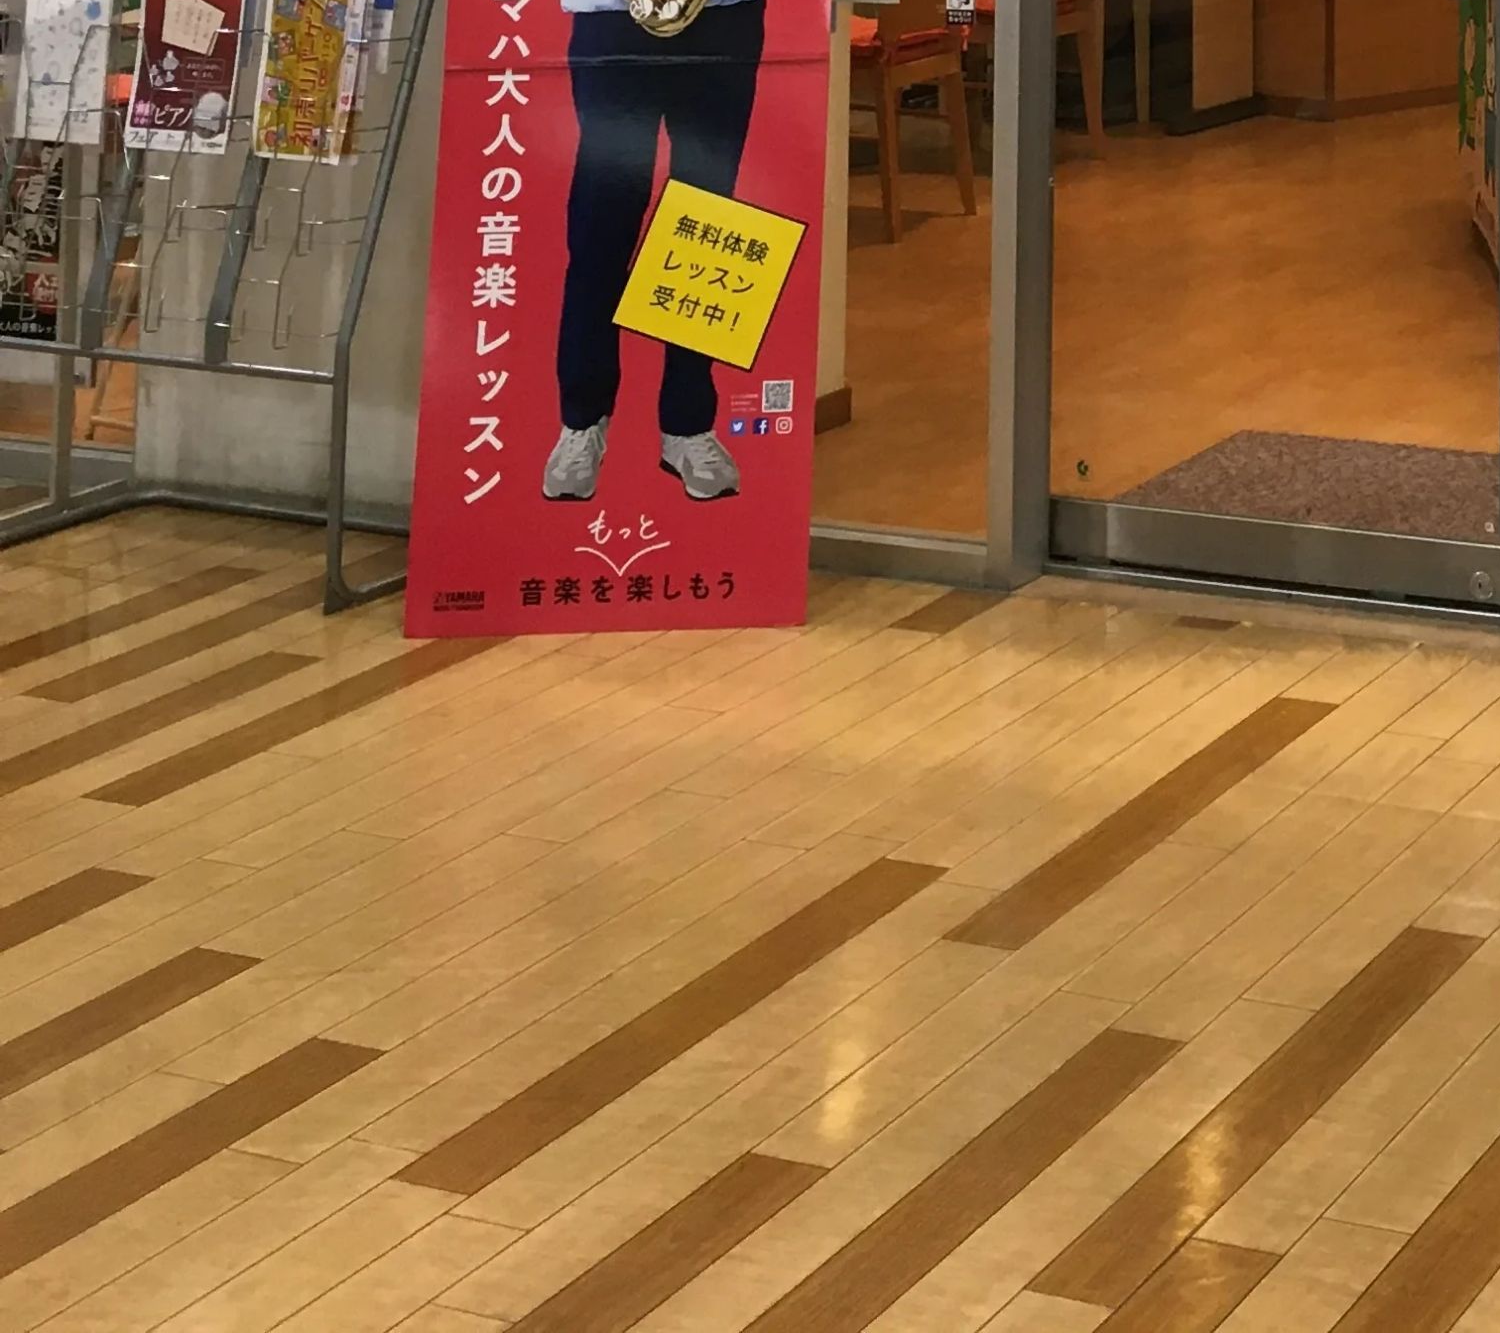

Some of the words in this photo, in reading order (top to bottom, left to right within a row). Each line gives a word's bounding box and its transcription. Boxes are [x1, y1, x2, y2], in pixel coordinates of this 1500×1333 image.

[673, 214, 769, 267] 無料体験
[662, 249, 755, 295] レッスン
[649, 285, 742, 332] 受付中！
[588, 510, 659, 544] もっと
[519, 571, 735, 606] 音楽を楽しもう
